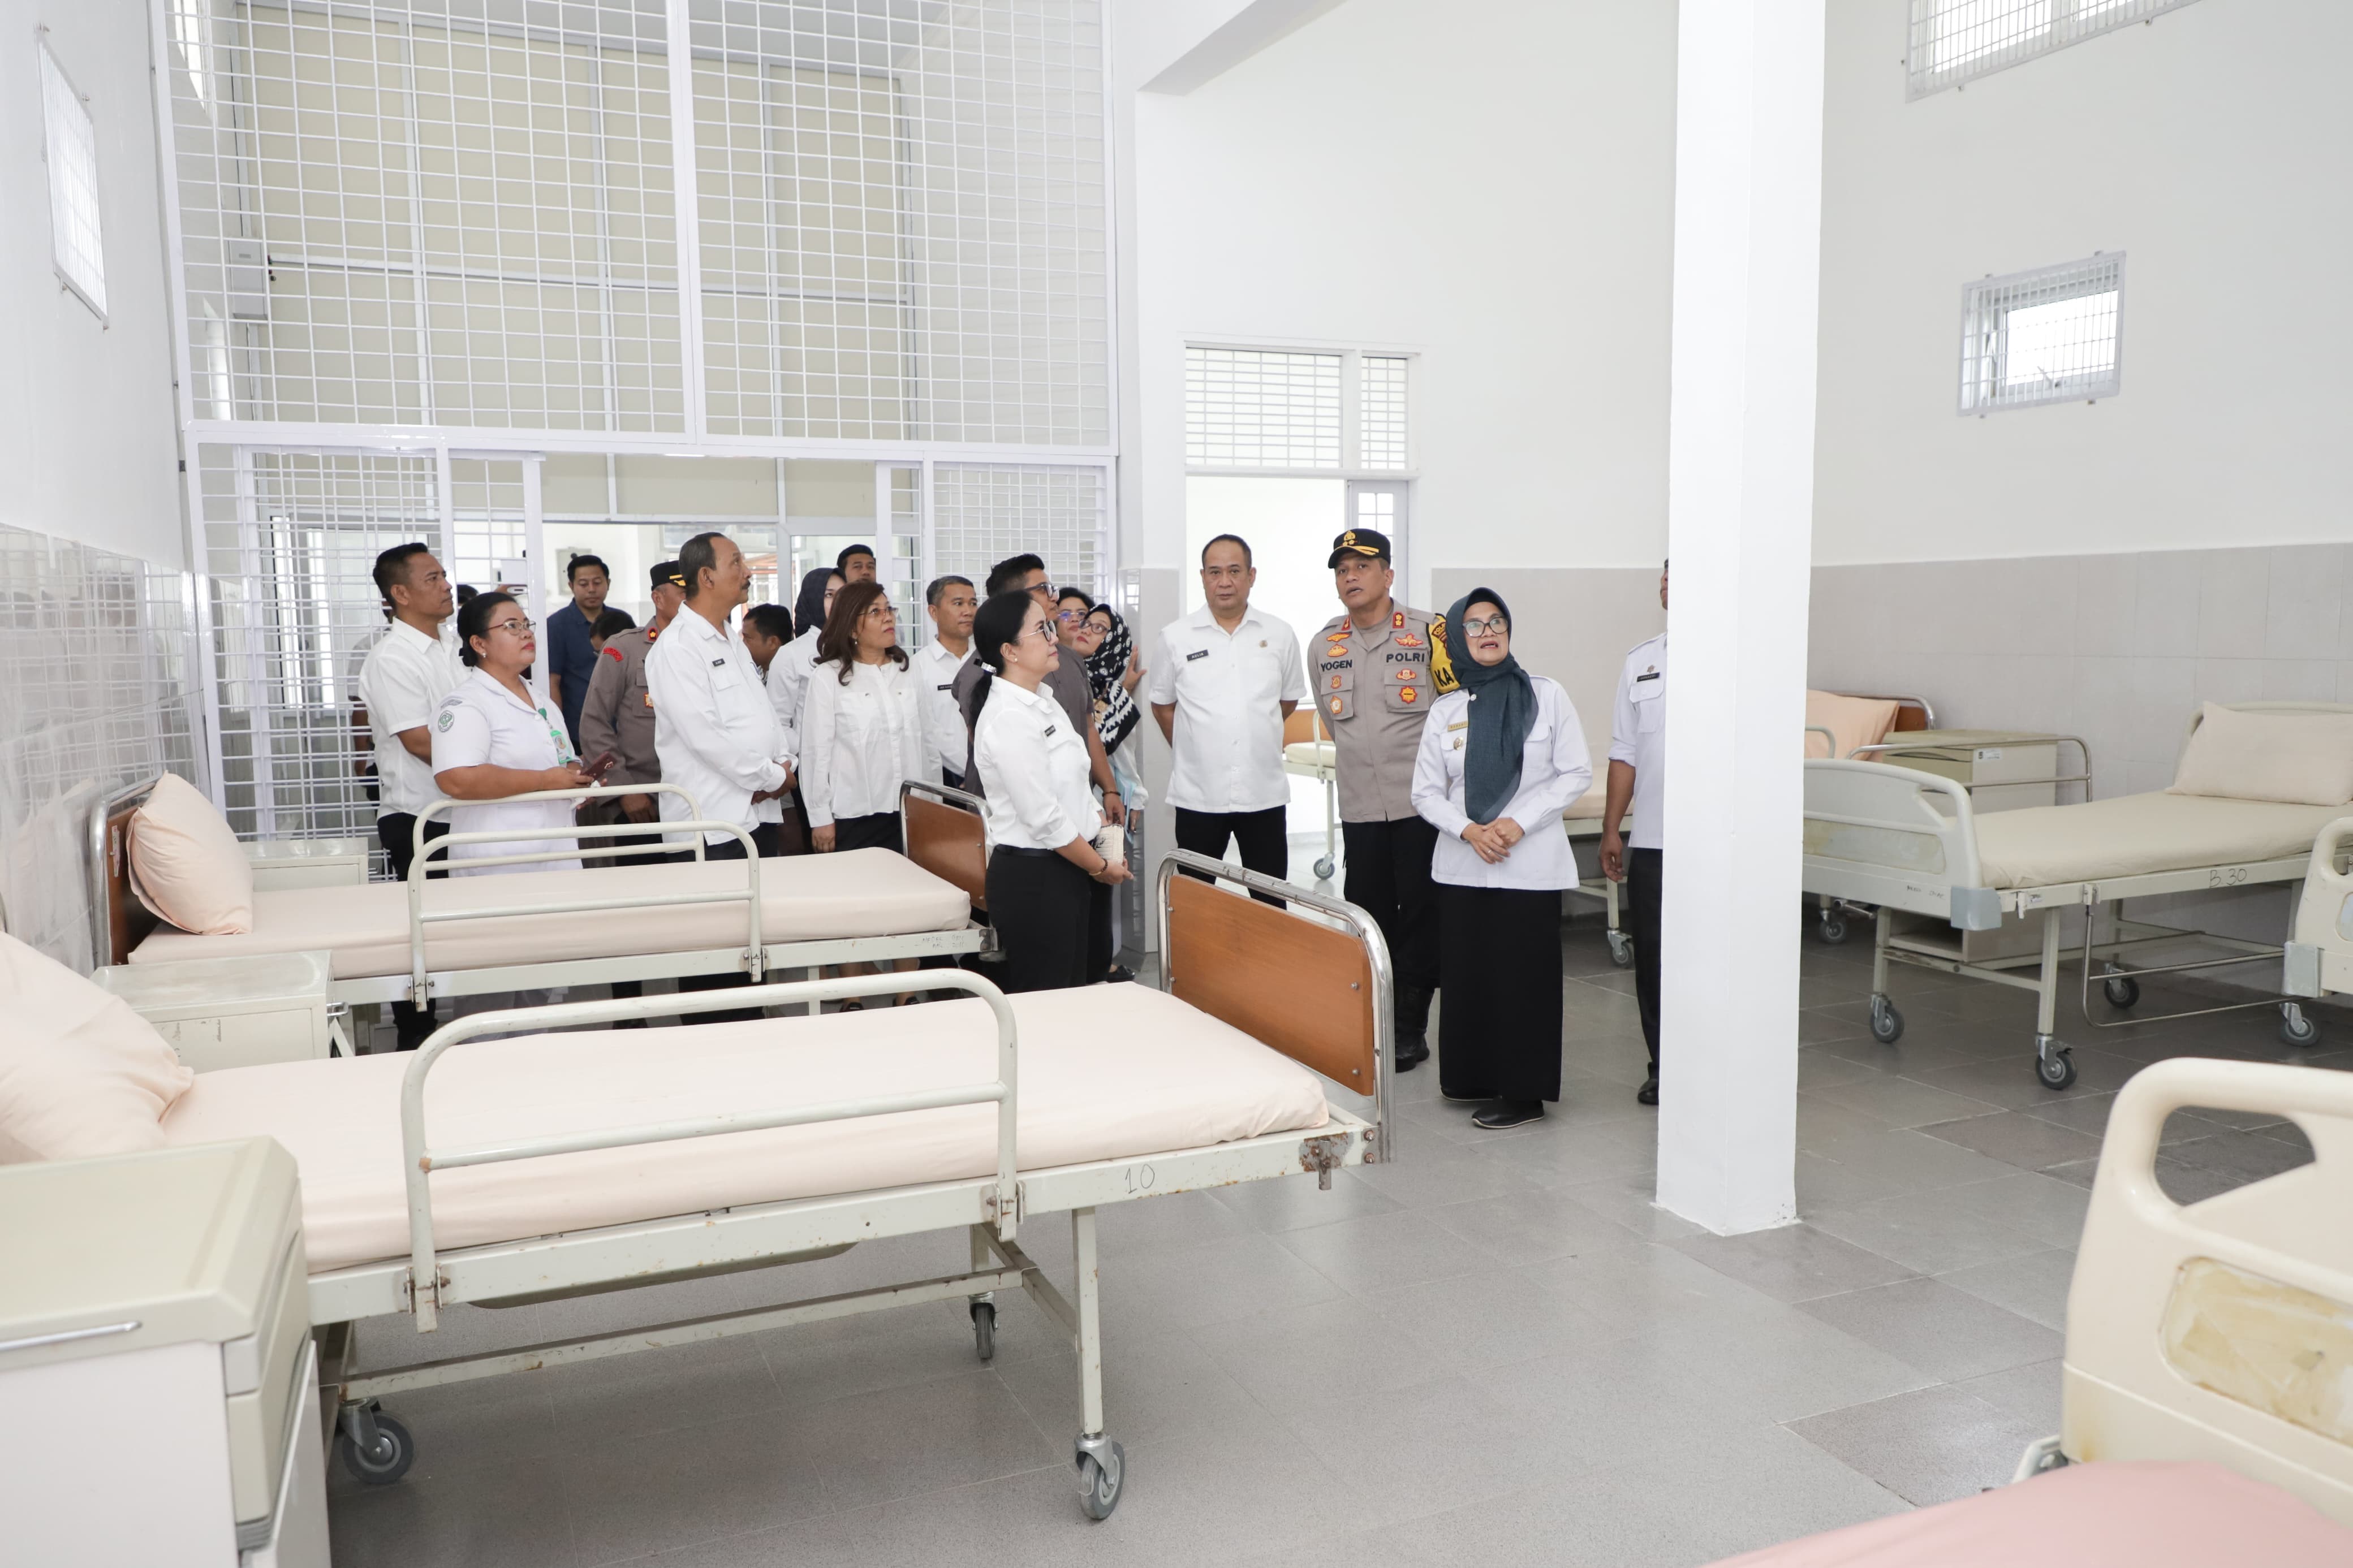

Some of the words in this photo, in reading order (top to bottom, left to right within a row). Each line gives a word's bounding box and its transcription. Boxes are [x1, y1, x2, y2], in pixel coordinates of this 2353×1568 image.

[1320, 659, 1353, 672] YOGEN
[1386, 653, 1425, 663] POLRI
[1434, 667, 1454, 687] KA
[1124, 1164, 1155, 1194] 10
